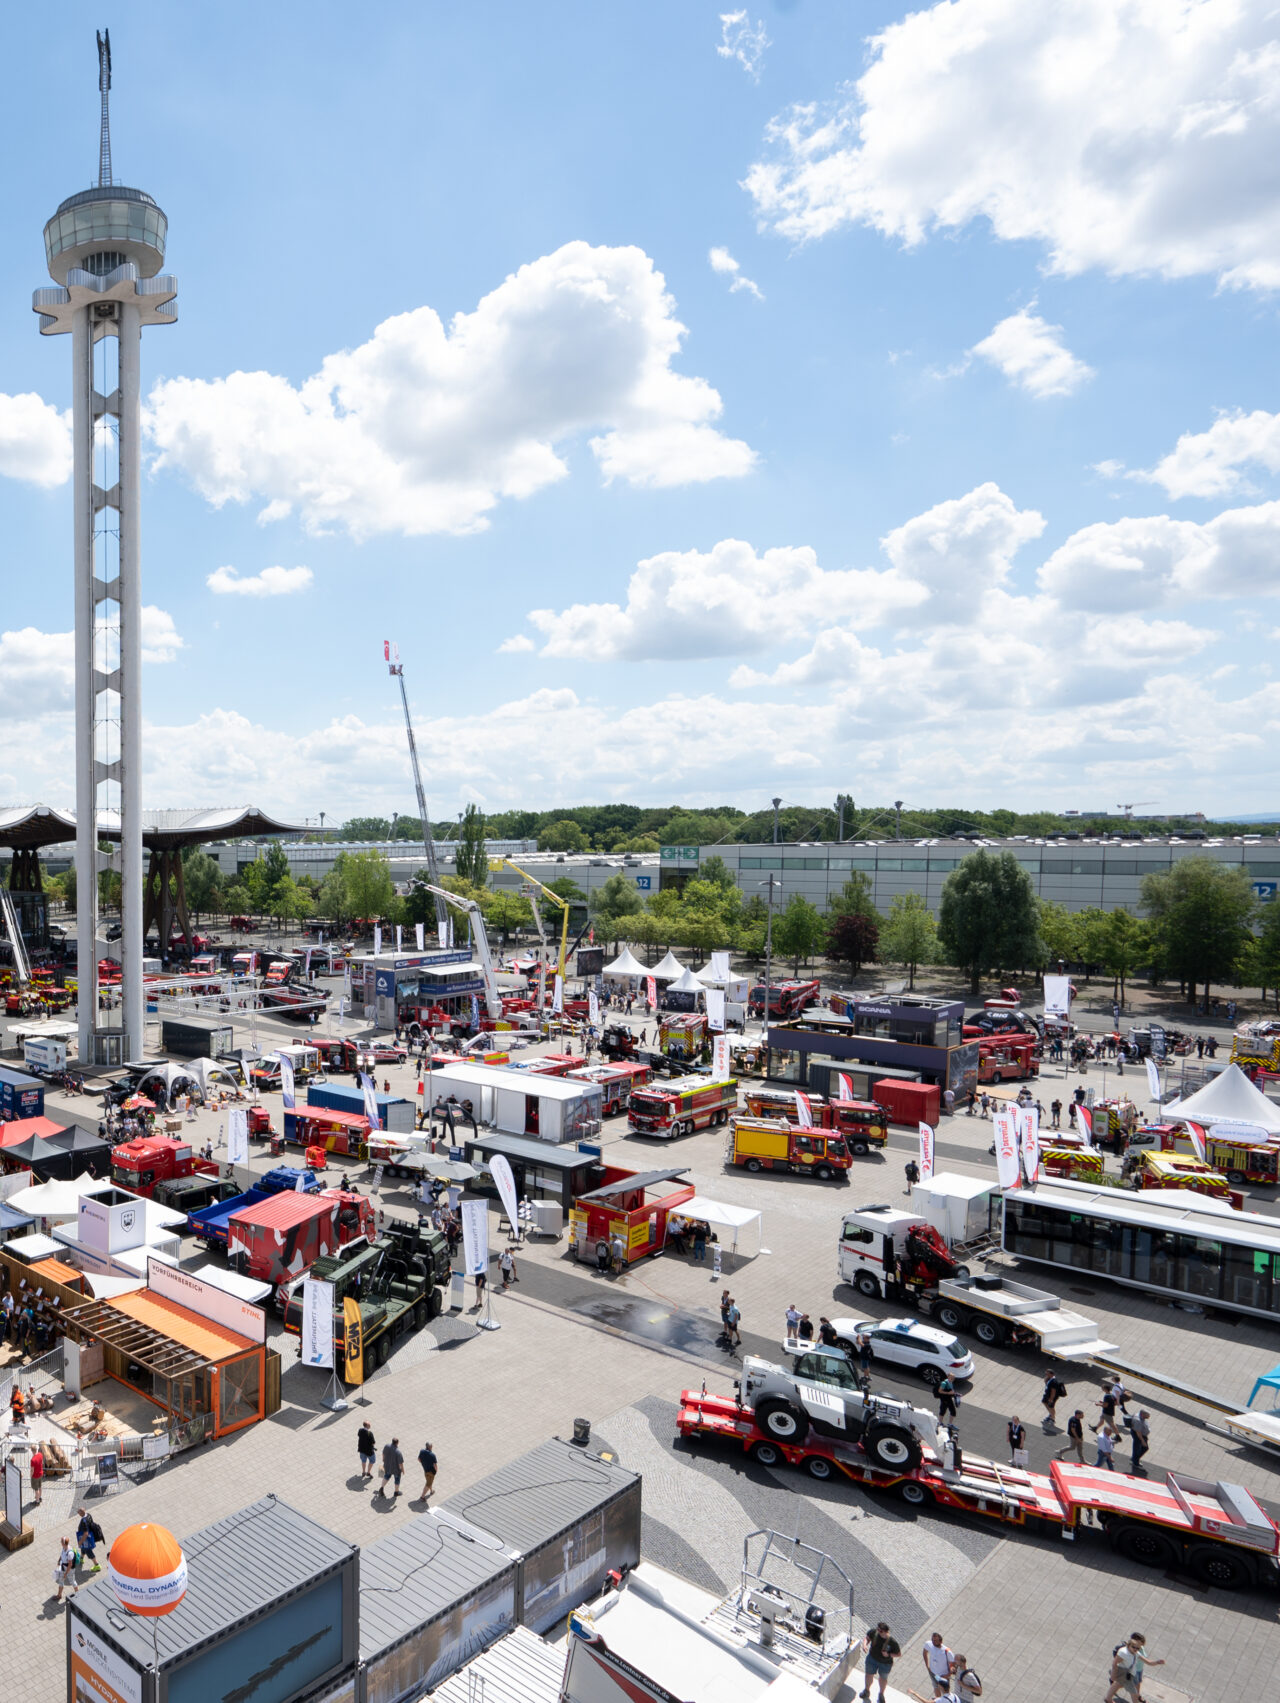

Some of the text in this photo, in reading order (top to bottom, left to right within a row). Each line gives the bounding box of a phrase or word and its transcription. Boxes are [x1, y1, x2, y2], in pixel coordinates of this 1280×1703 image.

[638, 878, 648, 887] 12
[1252, 886, 1271, 897] 12
[858, 1006, 891, 1014] SCANIA
[152, 1265, 203, 1293] VORFÜHRBEREICH
[241, 1307, 261, 1320] STIHL
[112, 1575, 146, 1593] GENERAL
[87, 1639, 108, 1662] MOBILE
[86, 1649, 136, 1698] BRÜCKENSYSTEME
[604, 1650, 669, 1700] www.Lentner-GmbH.de
